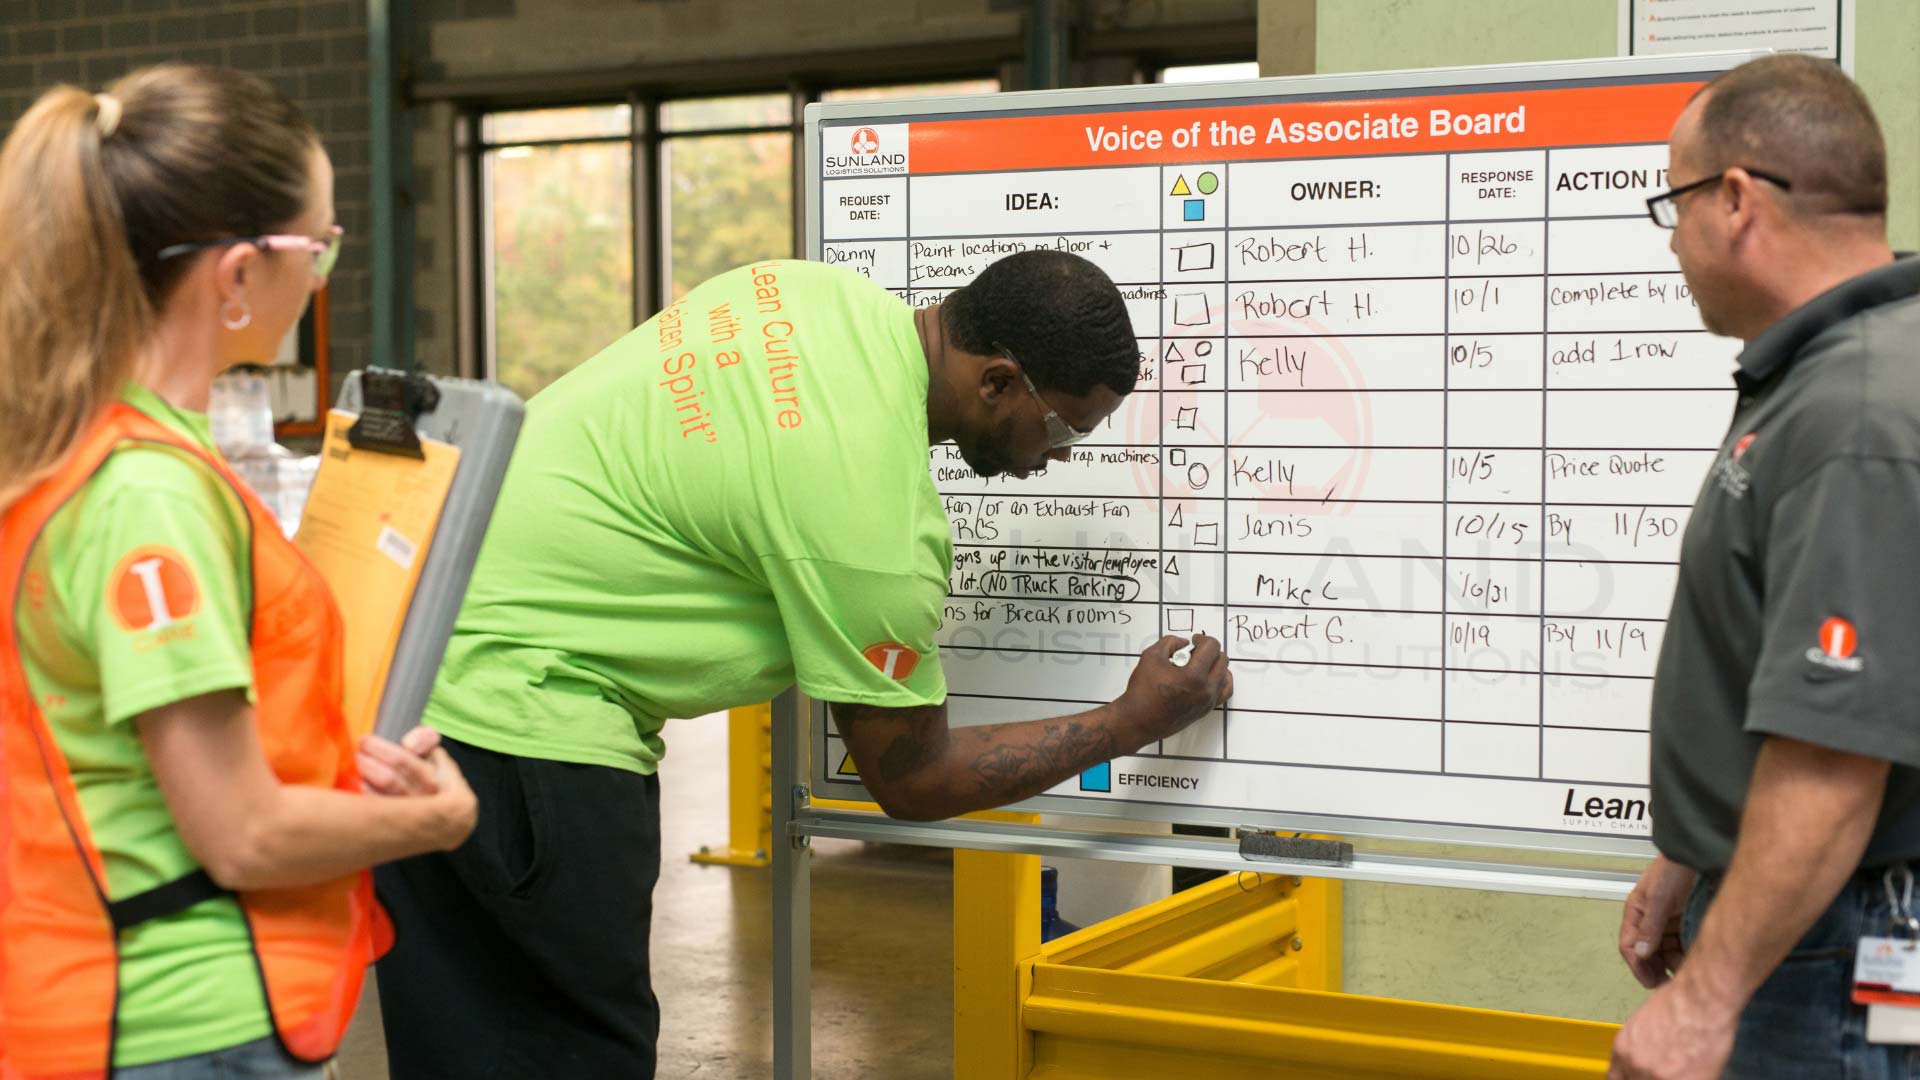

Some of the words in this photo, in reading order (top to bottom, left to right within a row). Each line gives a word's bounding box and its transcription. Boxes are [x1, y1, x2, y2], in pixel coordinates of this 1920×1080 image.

[1086, 126, 1163, 153] Voice
[1172, 124, 1202, 148] of
[1209, 118, 1257, 147] the
[1265, 112, 1419, 144] Associate
[1428, 105, 1526, 138] Board
[825, 152, 905, 168] SUNLAND
[863, 165, 905, 174] SOLUTIONS
[1460, 170, 1534, 185] RESPONSE
[1556, 169, 1647, 192] ACTION
[839, 194, 891, 208] REQUEST
[1005, 192, 1059, 212] IDEA:
[1290, 180, 1382, 202] OWNER:
[1477, 186, 1517, 200] DATE:
[849, 209, 881, 221] DATE:
[826, 247, 876, 267] Danny
[911, 241, 956, 259] Paint
[961, 239, 1027, 258] locations
[1054, 236, 1094, 253] floor
[1235, 235, 1328, 266] Robert
[1347, 235, 1374, 260] H.
[1455, 287, 1500, 317] 10/1
[1648, 279, 1667, 304] by
[1236, 292, 1333, 321] Robert
[1353, 292, 1378, 320] H.
[708, 301, 744, 344] with
[715, 350, 741, 370] a
[1452, 343, 1494, 368] 10/5
[1552, 339, 1596, 366] add
[762, 320, 803, 430] Culture
[1238, 343, 1308, 387] Kelly
[1100, 448, 1160, 465] machines
[1450, 451, 1496, 481] 10/5
[1550, 453, 1601, 479] Price
[1609, 453, 1665, 475] Quote
[1232, 455, 1295, 496] Kelly
[1010, 503, 1028, 517] an
[1035, 501, 1100, 518] Exhaust
[1102, 501, 1130, 518] Fan
[1238, 513, 1313, 541] Janis
[1455, 511, 1529, 545] 10/15
[1549, 513, 1573, 546] By
[1614, 505, 1679, 548] 11/30
[953, 547, 982, 569] igns
[990, 551, 1006, 571] up
[1015, 548, 1030, 565] in
[1032, 548, 1060, 569] the
[1068, 577, 1126, 600] Parking
[972, 600, 997, 622] for
[1229, 613, 1319, 643] Robert
[1544, 622, 1575, 652] By
[1118, 772, 1200, 791] EFFICIENCY
[1563, 788, 1652, 821] Lean
[1562, 817, 1603, 828] SUPPLY
[1610, 821, 1649, 831] CHAIN
